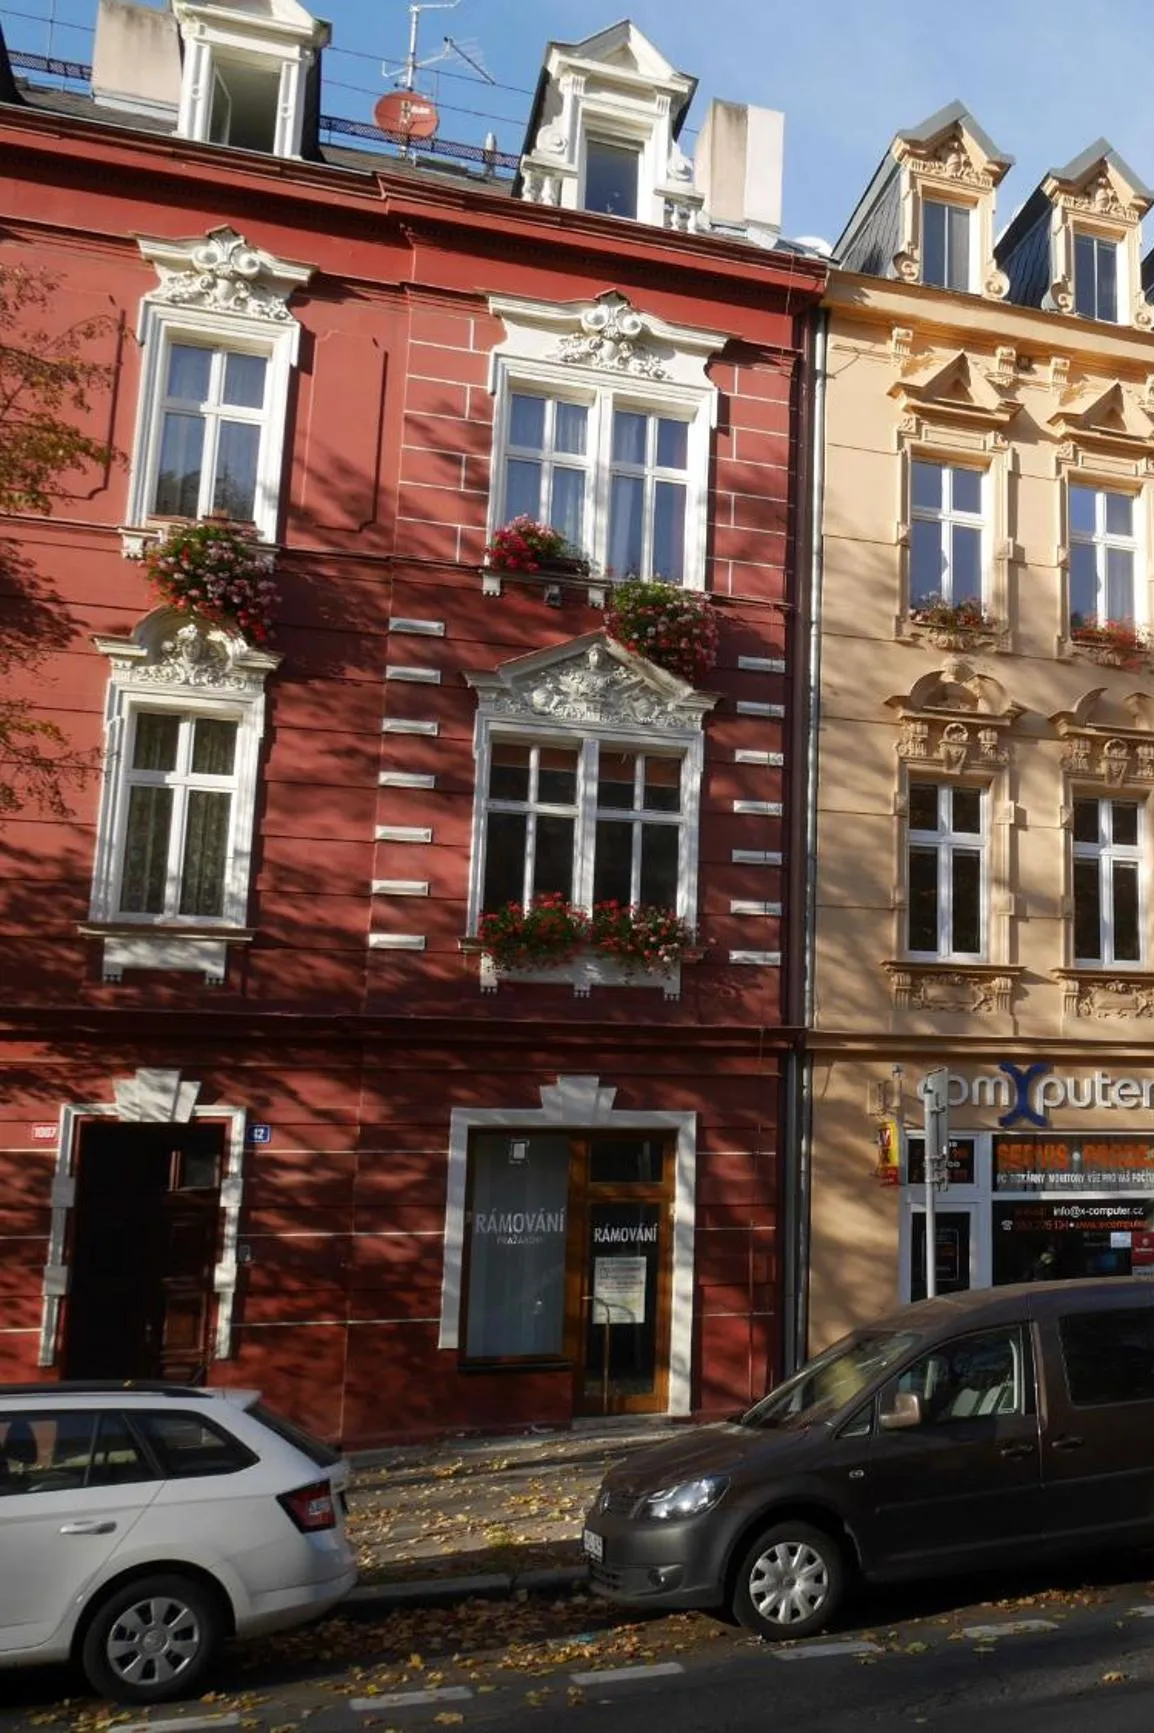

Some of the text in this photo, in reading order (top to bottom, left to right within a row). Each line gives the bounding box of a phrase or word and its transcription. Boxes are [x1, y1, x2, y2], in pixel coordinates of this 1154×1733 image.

[254, 1128, 264, 1139] 12
[475, 1208, 566, 1233] RÁMOVÁNÍ
[594, 1222, 659, 1243] RÁMOVÁNÍ
